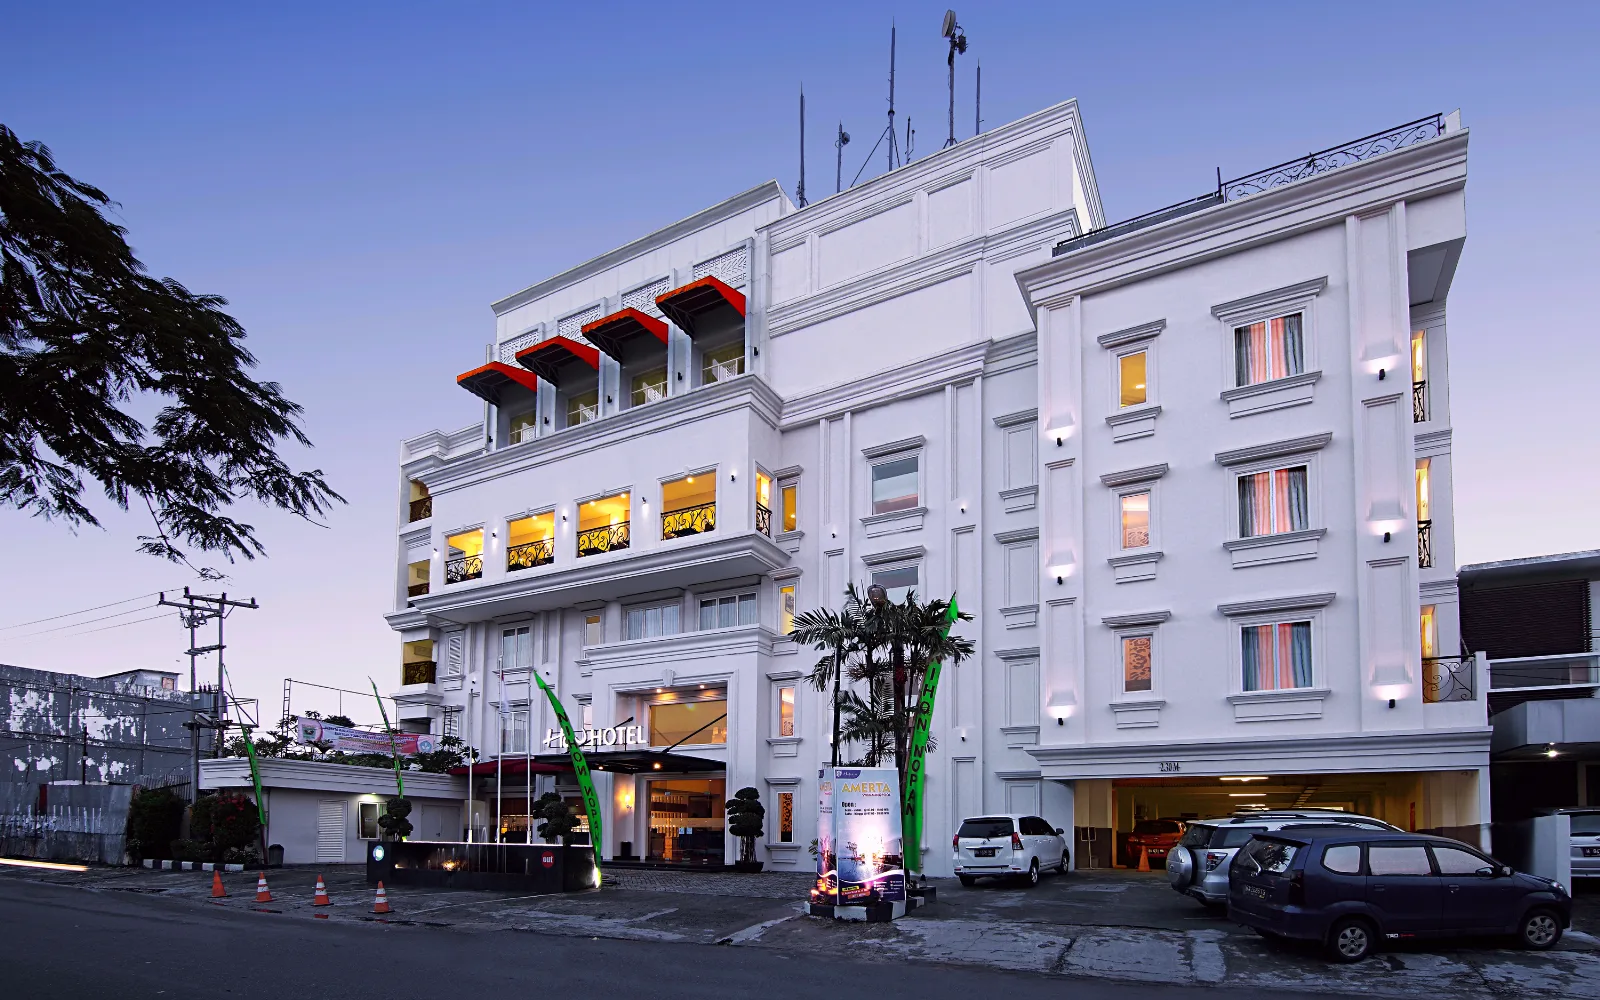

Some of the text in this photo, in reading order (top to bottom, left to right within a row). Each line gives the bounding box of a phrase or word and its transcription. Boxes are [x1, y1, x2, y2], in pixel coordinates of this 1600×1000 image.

[591, 725, 648, 746] HOTEL
[841, 782, 891, 793] AMERTA
[905, 744, 924, 817] NOPAN
